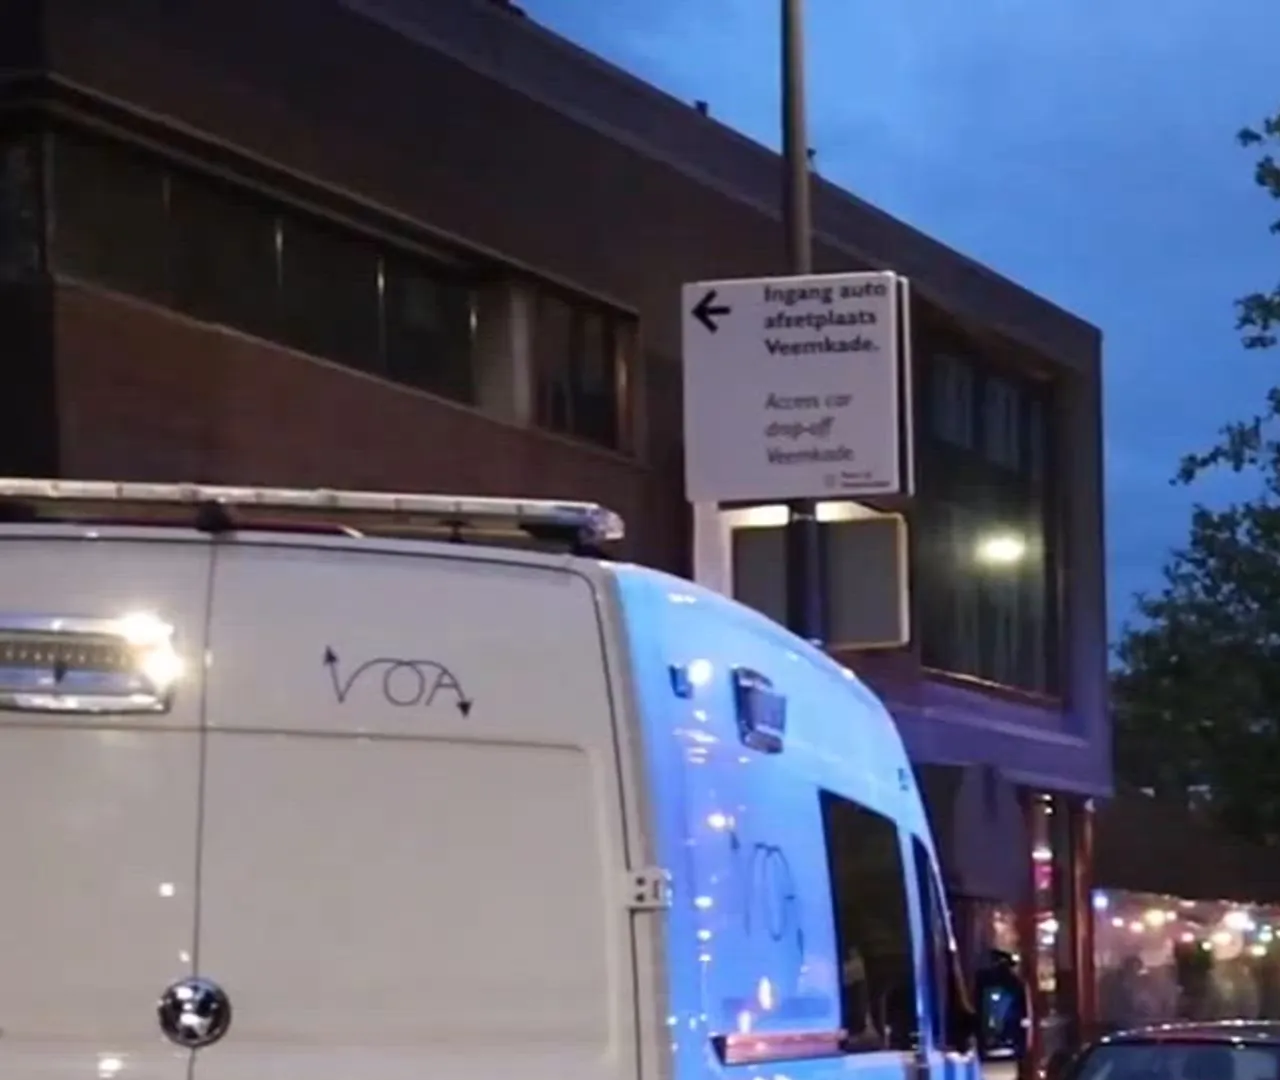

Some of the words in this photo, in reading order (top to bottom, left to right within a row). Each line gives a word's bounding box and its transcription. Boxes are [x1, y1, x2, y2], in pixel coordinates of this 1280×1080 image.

[764, 284, 834, 305] Ingang
[839, 281, 888, 300] auto
[763, 309, 878, 332] afzetplaats
[764, 335, 881, 356] Veemkade.
